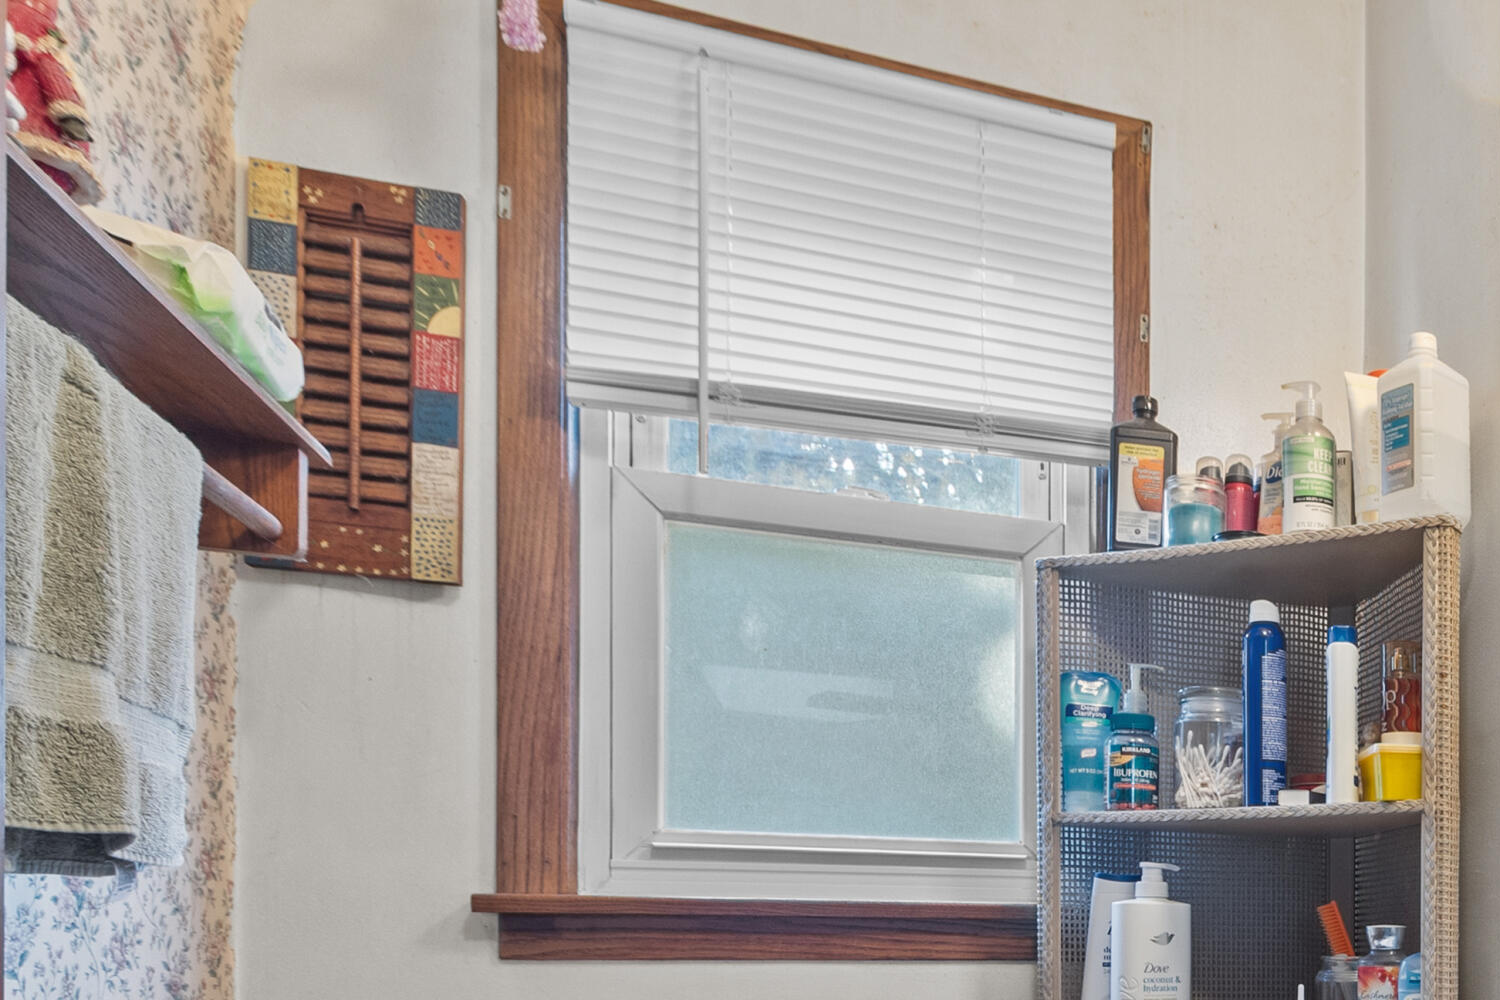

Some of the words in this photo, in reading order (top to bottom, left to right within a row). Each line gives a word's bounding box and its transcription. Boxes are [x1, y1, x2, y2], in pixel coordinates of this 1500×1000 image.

[1072, 709, 1107, 718] Clarifying
[1121, 746, 1151, 754] KIRKLAND
[1143, 962, 1170, 974] Dove
[1143, 976, 1174, 984] coconut
[1143, 984, 1178, 992] hydration
